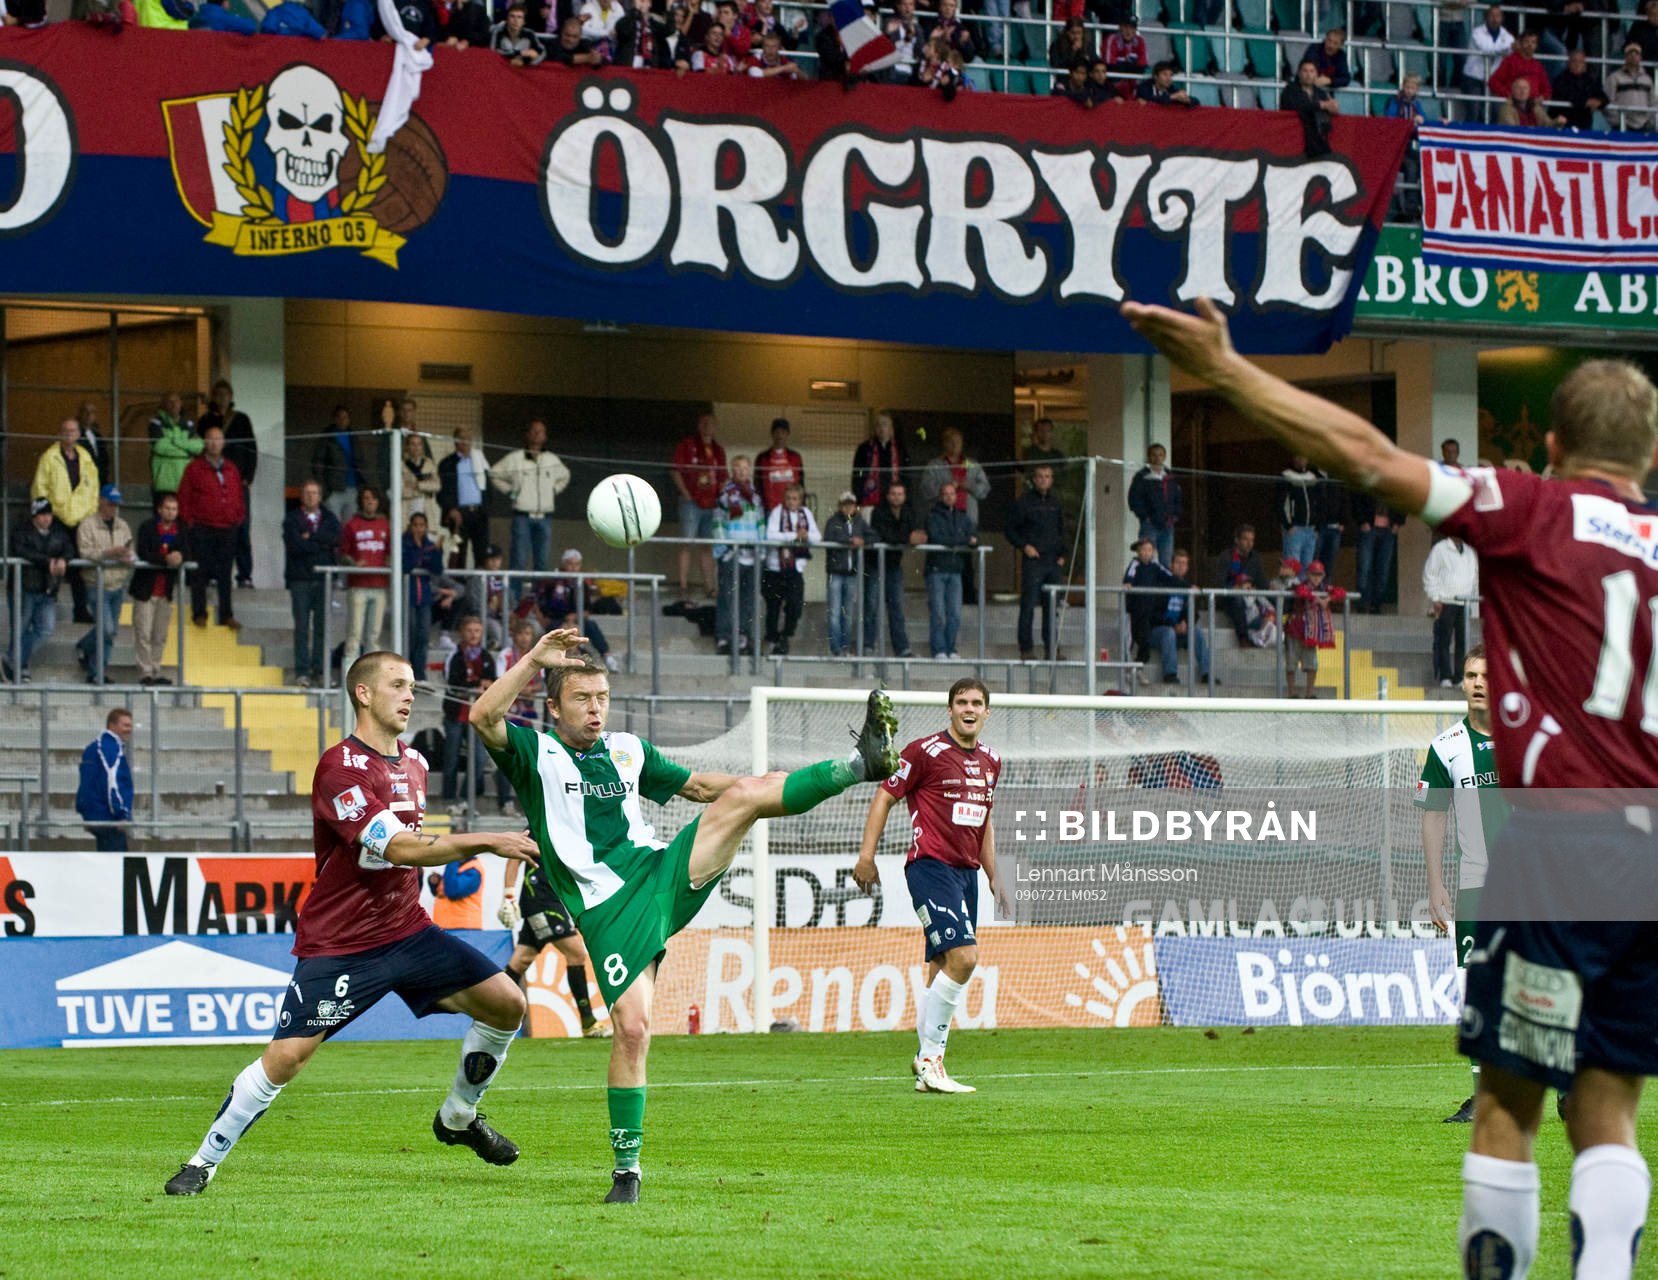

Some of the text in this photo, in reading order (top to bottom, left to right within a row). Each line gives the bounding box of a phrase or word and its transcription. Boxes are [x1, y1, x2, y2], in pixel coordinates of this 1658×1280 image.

[545, 85, 1364, 311] ÖRGRYTE
[1421, 149, 1658, 241] FANATIC
[250, 224, 332, 251] INFERNO
[1574, 271, 1658, 315] AB
[122, 857, 314, 936] MARK
[1122, 898, 1455, 938] GAMLA ULLE
[334, 974, 350, 998] 6
[604, 952, 629, 987] 8
[1236, 949, 1461, 1025] Björnk
[57, 993, 173, 1034] TUVE
